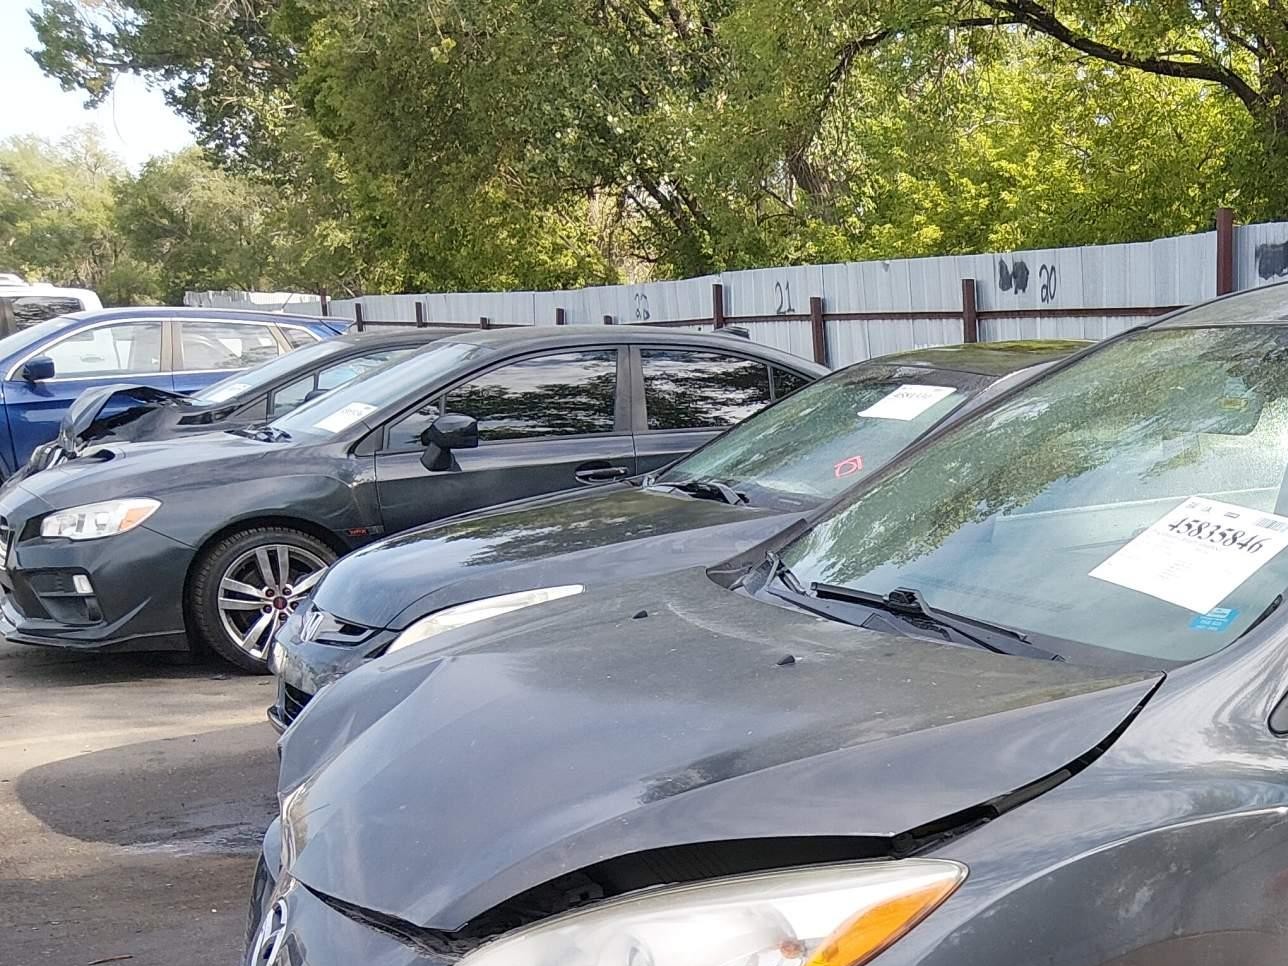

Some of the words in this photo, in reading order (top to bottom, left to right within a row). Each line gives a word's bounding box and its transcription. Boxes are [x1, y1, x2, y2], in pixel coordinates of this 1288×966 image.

[774, 280, 795, 315] 21
[1039, 263, 1057, 304] 20
[1168, 517, 1273, 554] 45835846
